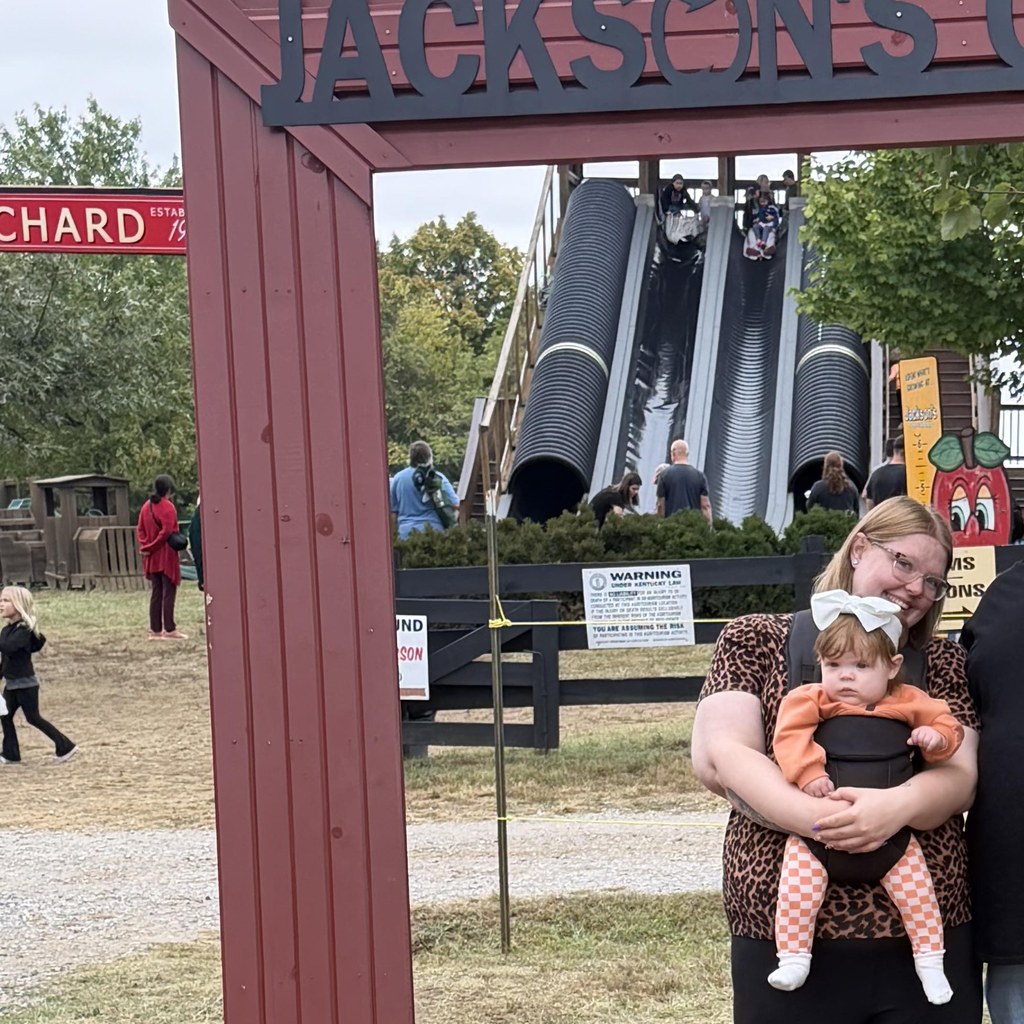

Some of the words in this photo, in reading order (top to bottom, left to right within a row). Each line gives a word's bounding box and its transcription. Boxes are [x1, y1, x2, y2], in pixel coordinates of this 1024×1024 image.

[265, 0, 937, 102] JACKSONS
[0, 206, 145, 244] CHARD
[610, 571, 682, 581] WARNING
[398, 646, 423, 661] SON
